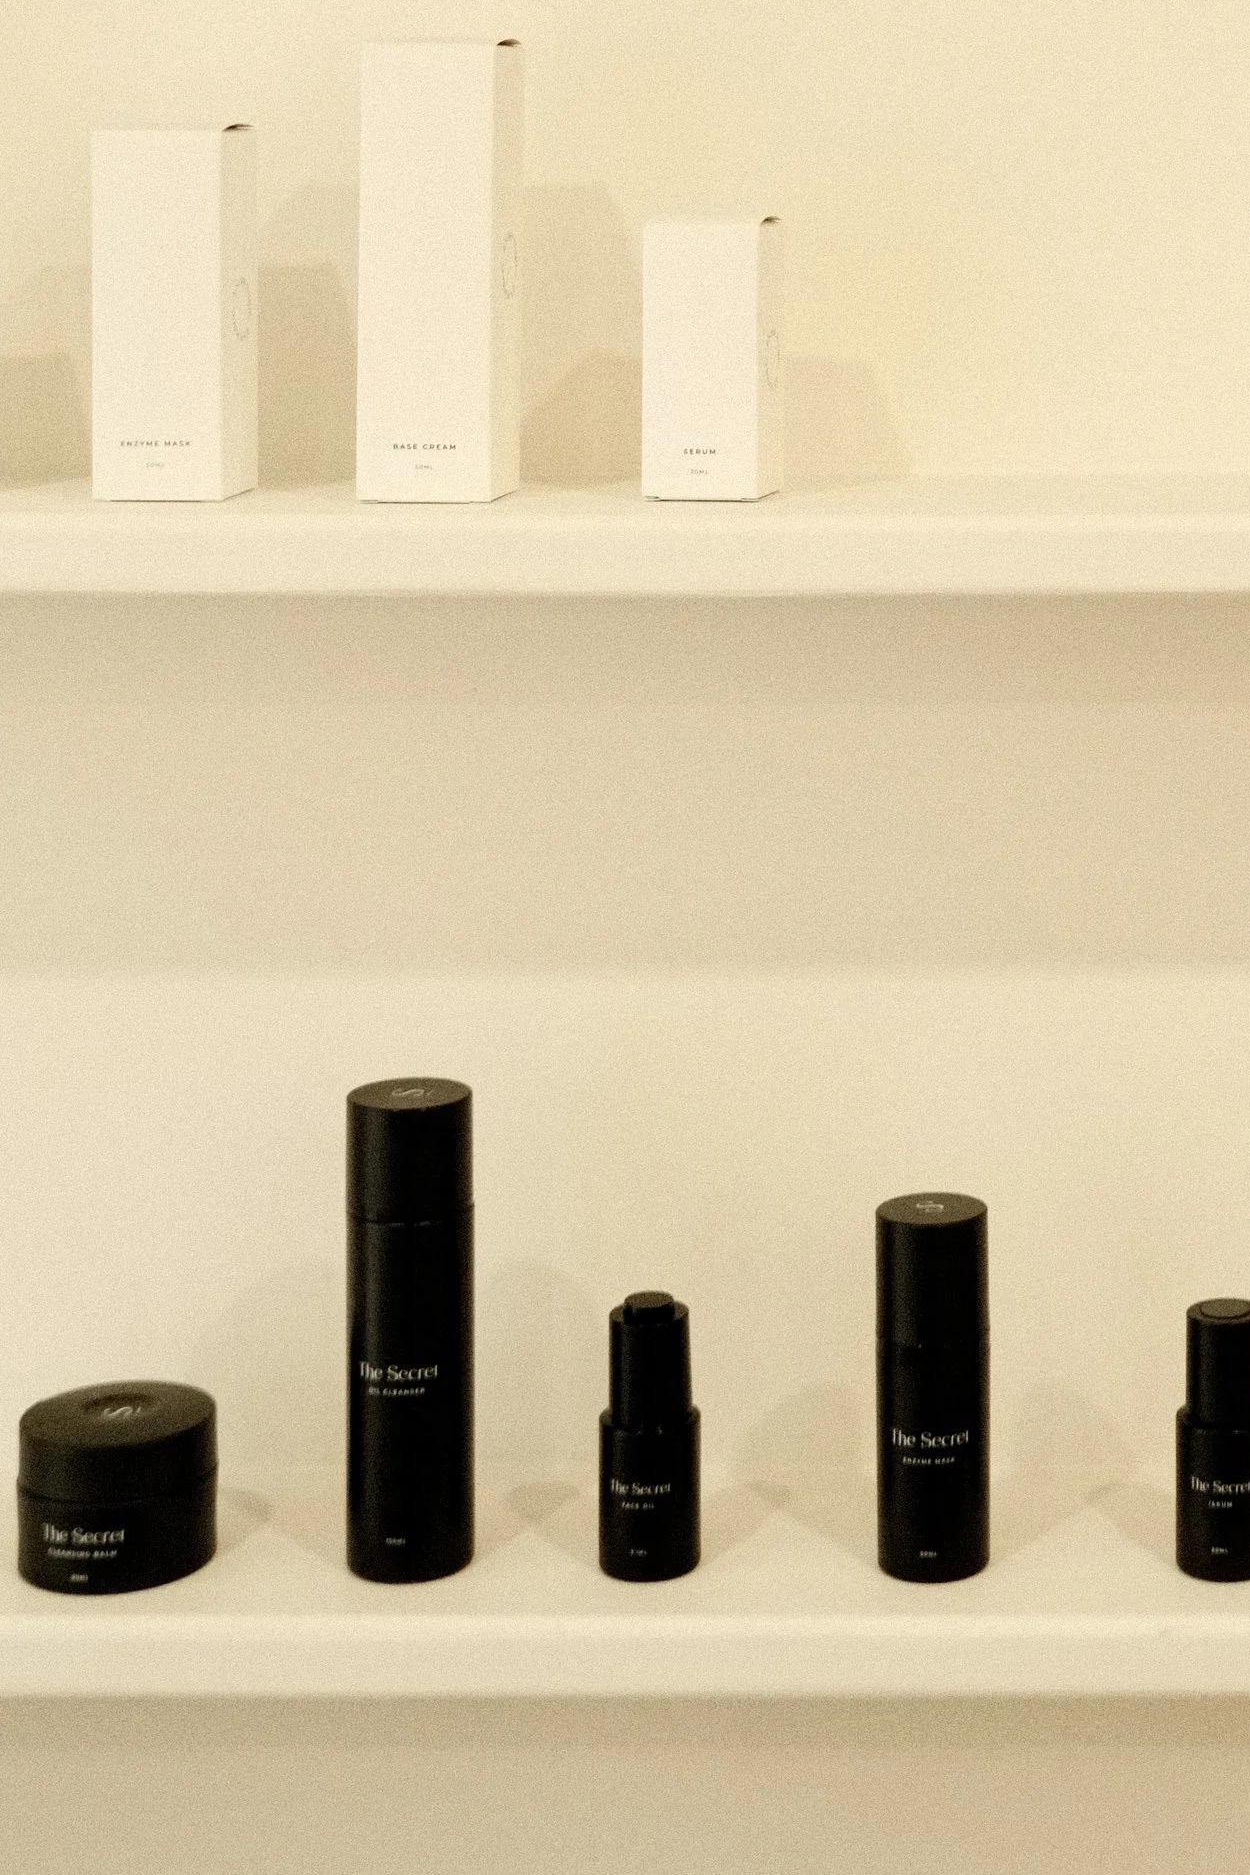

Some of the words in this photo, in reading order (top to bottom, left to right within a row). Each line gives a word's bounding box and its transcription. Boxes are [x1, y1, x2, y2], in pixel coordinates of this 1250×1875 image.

[359, 1360, 383, 1381] The
[387, 1363, 438, 1382] Secret
[891, 1427, 916, 1448] The
[920, 1431, 969, 1449] Secret
[610, 1478, 629, 1495] The
[632, 1482, 671, 1496] Secret
[1190, 1475, 1210, 1493] The
[1213, 1480, 1250, 1495] Secret
[42, 1523, 68, 1544] The
[72, 1526, 125, 1545] Secret
